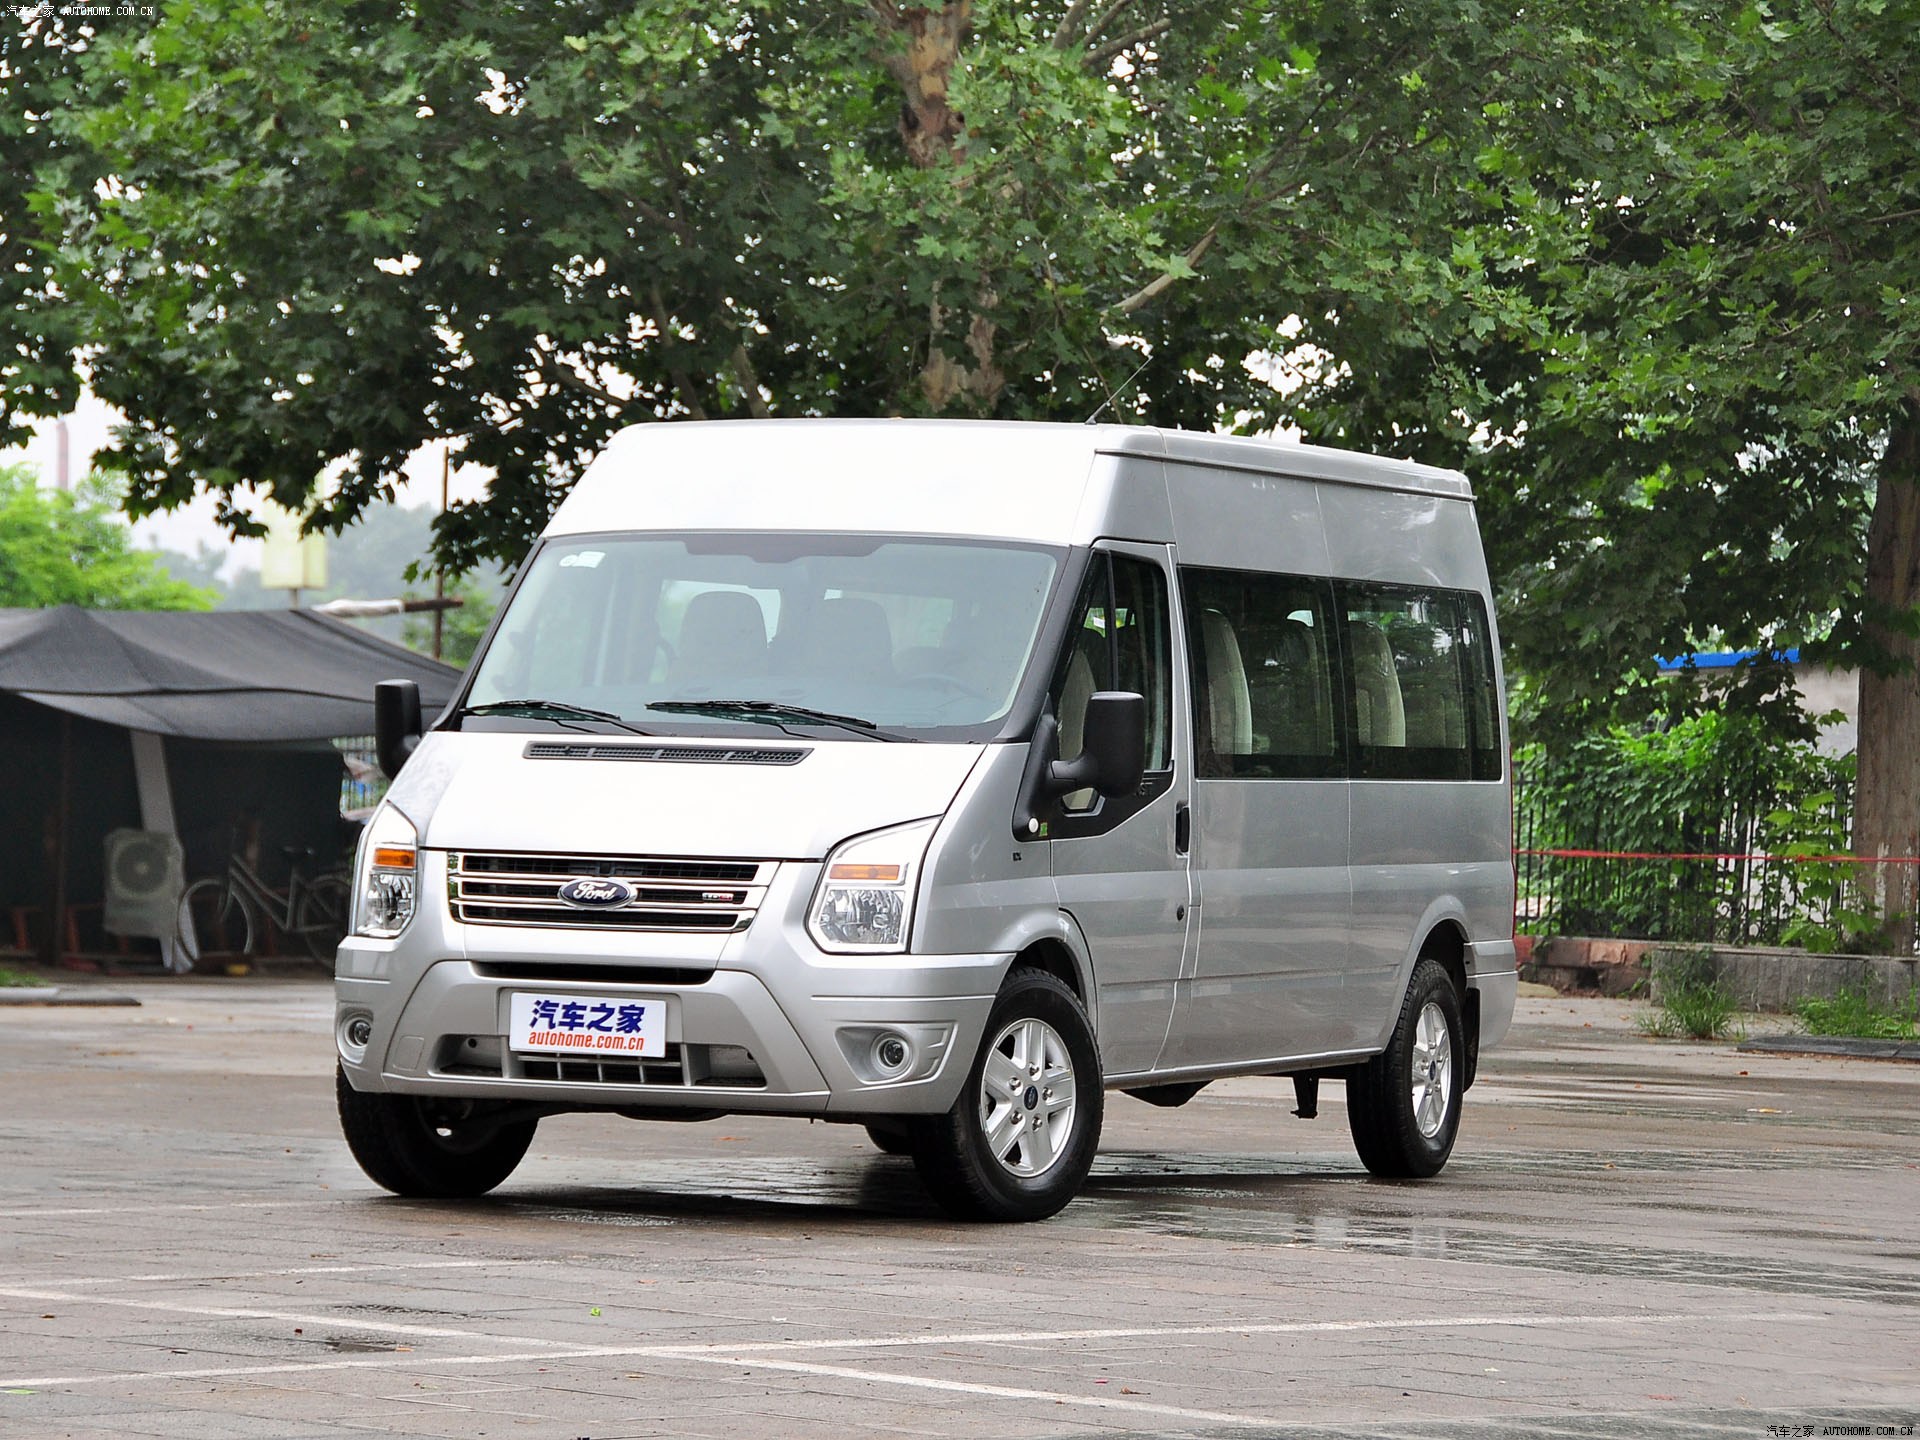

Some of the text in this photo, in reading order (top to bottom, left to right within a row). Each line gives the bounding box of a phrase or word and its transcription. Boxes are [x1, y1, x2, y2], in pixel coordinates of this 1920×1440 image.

[572, 881, 618, 900] Ford
[529, 1000, 646, 1034] 汽车之家
[528, 1031, 645, 1051] autohome.com.cn
